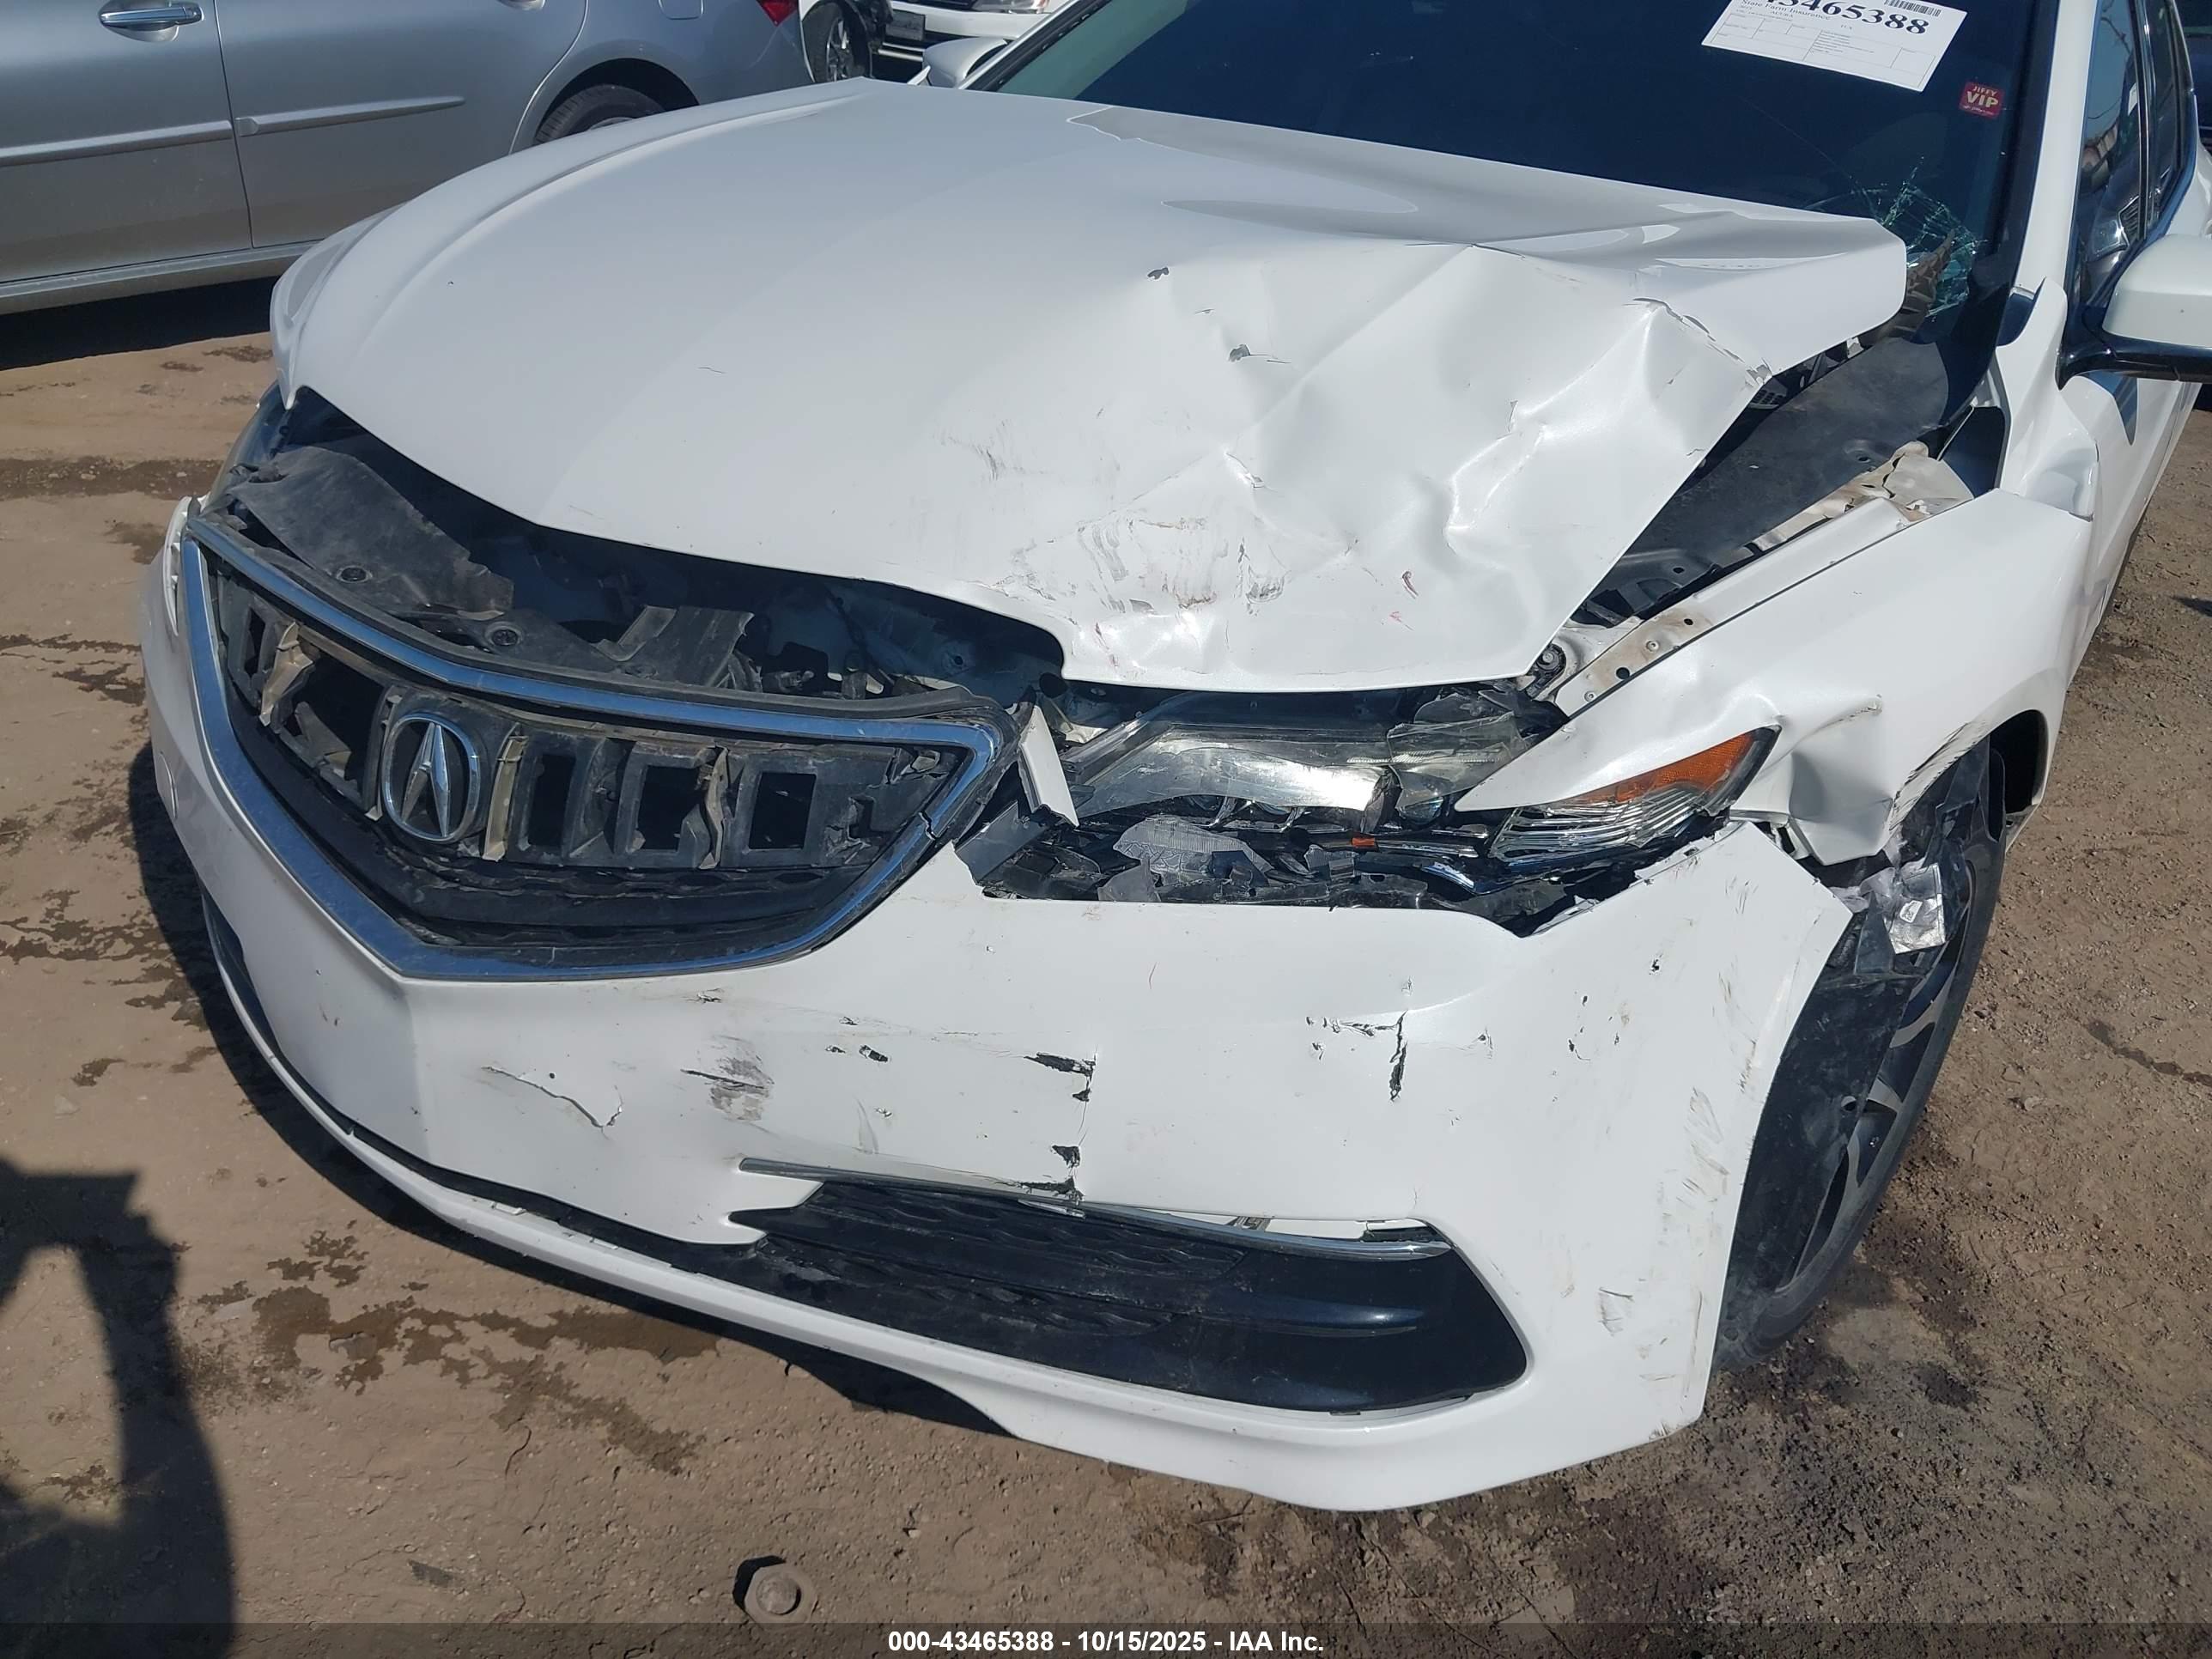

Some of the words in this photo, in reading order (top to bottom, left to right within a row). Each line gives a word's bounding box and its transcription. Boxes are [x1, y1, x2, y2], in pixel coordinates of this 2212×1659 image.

[1767, 0, 1929, 34] 465388
[1790, 8, 1831, 20] Insurance
[1966, 90, 1999, 108] VIP
